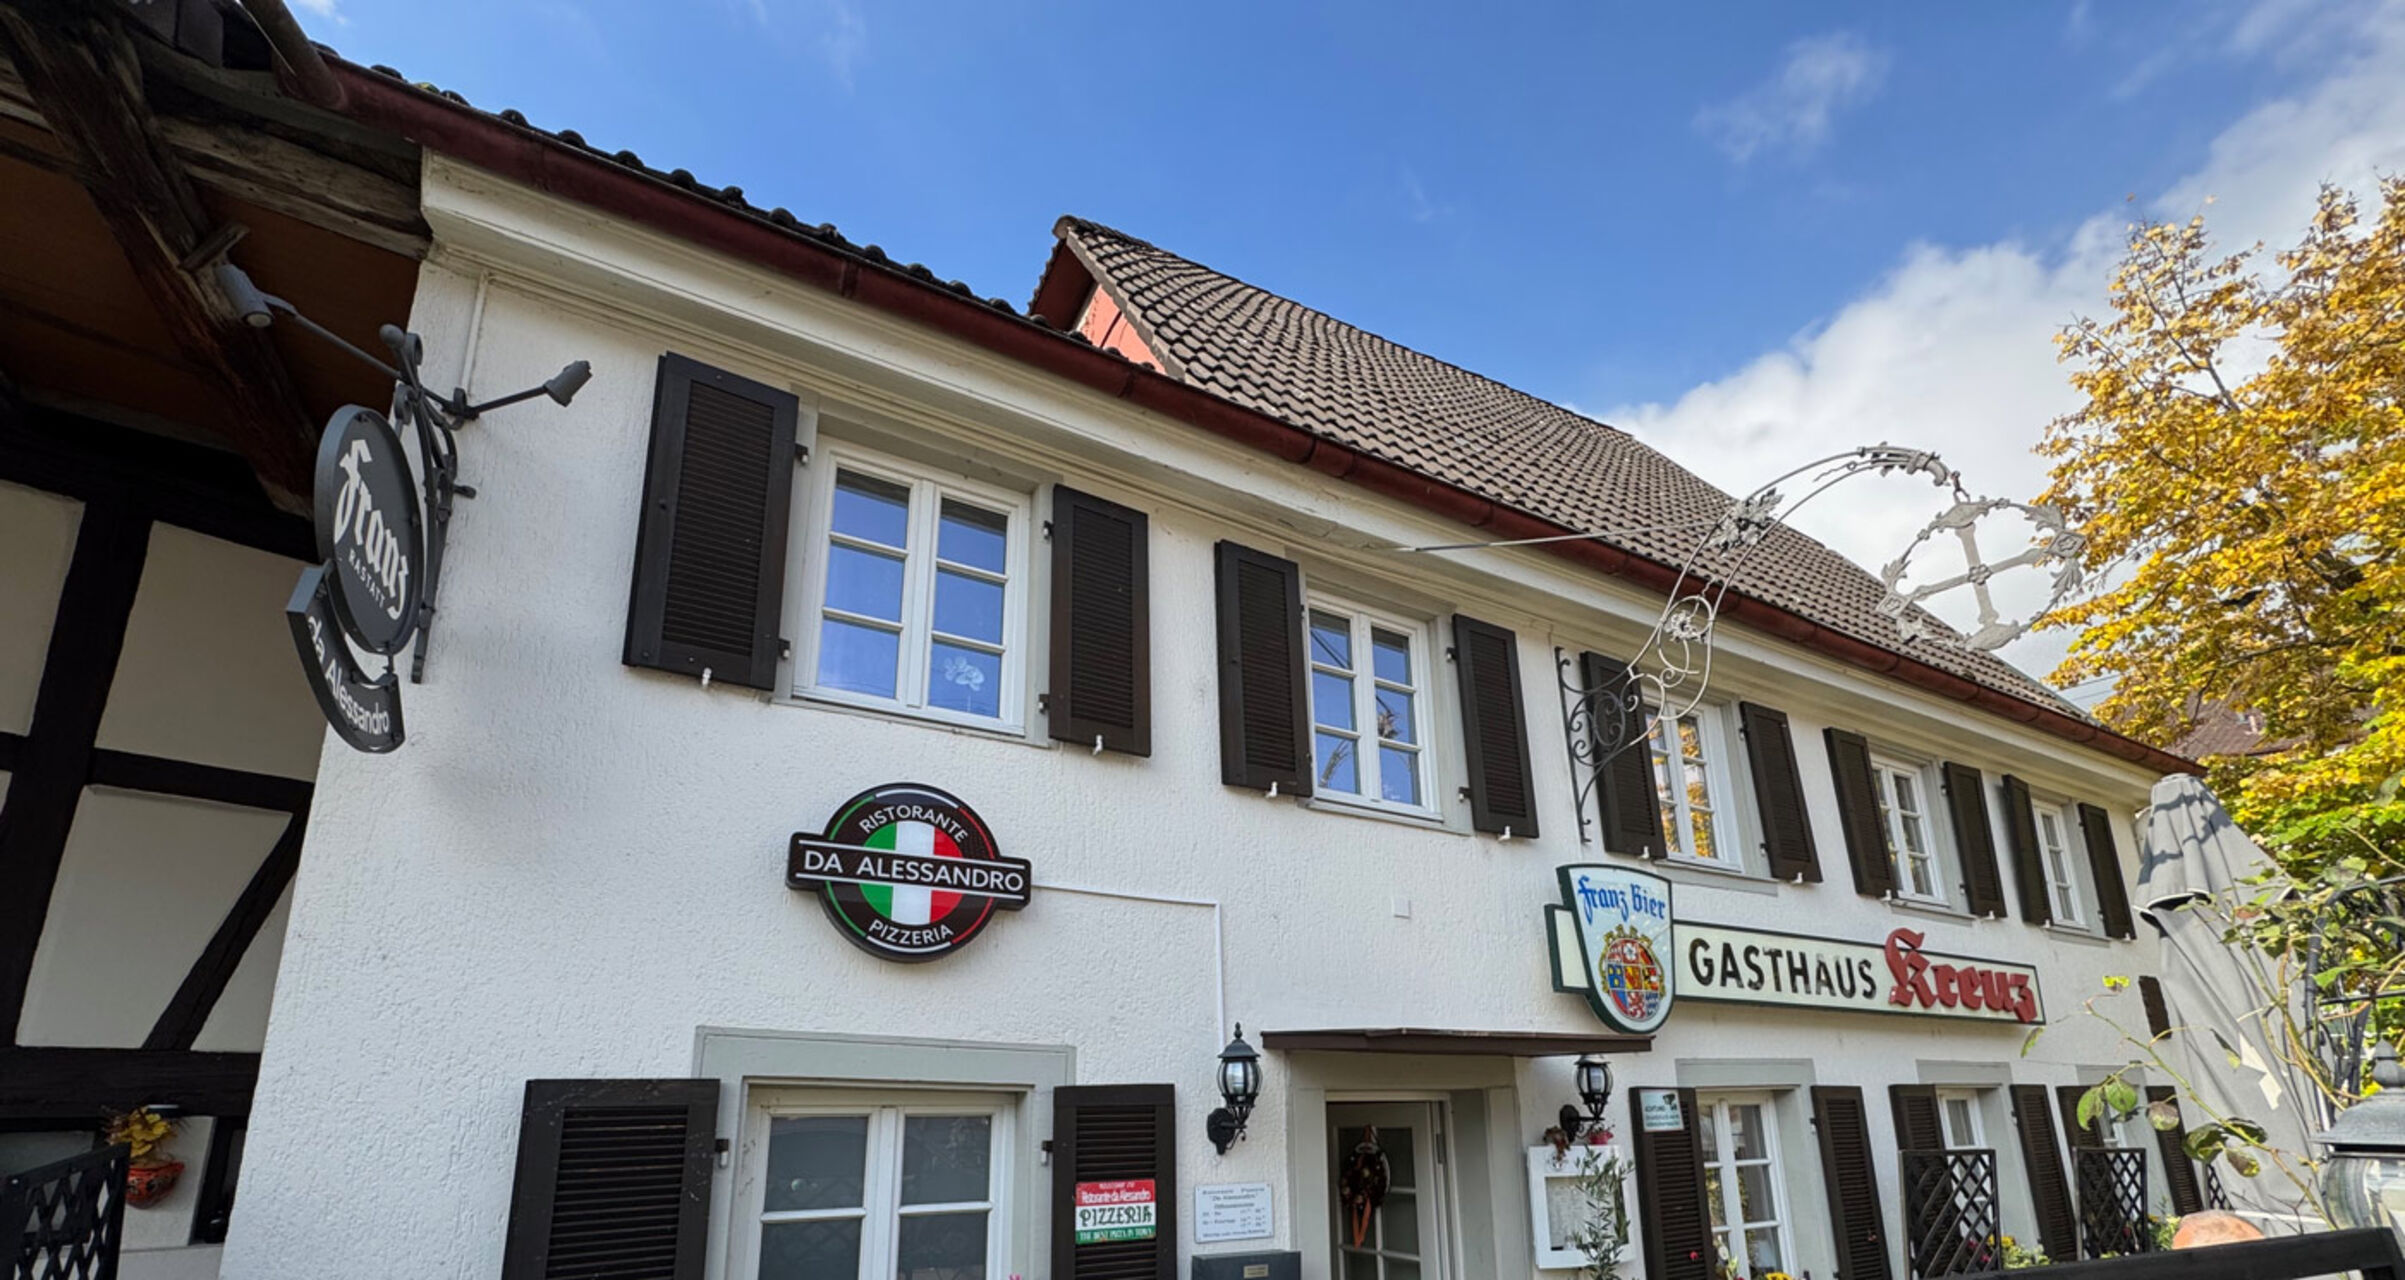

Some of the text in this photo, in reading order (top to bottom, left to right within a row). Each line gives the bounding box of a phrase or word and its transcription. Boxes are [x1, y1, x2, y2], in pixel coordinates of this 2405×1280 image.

[348, 548, 386, 609] RASTATT
[325, 659, 390, 735] Alessandro
[858, 804, 969, 843] RISTORANTE
[804, 850, 1024, 891] DA ALESSANDRO
[1630, 883, 1665, 920] Bier
[868, 919, 954, 945] PIZZERIA
[1688, 927, 2038, 1024] GASTHAUS Kreuz
[1079, 1205, 1152, 1227] PIZZERIA
